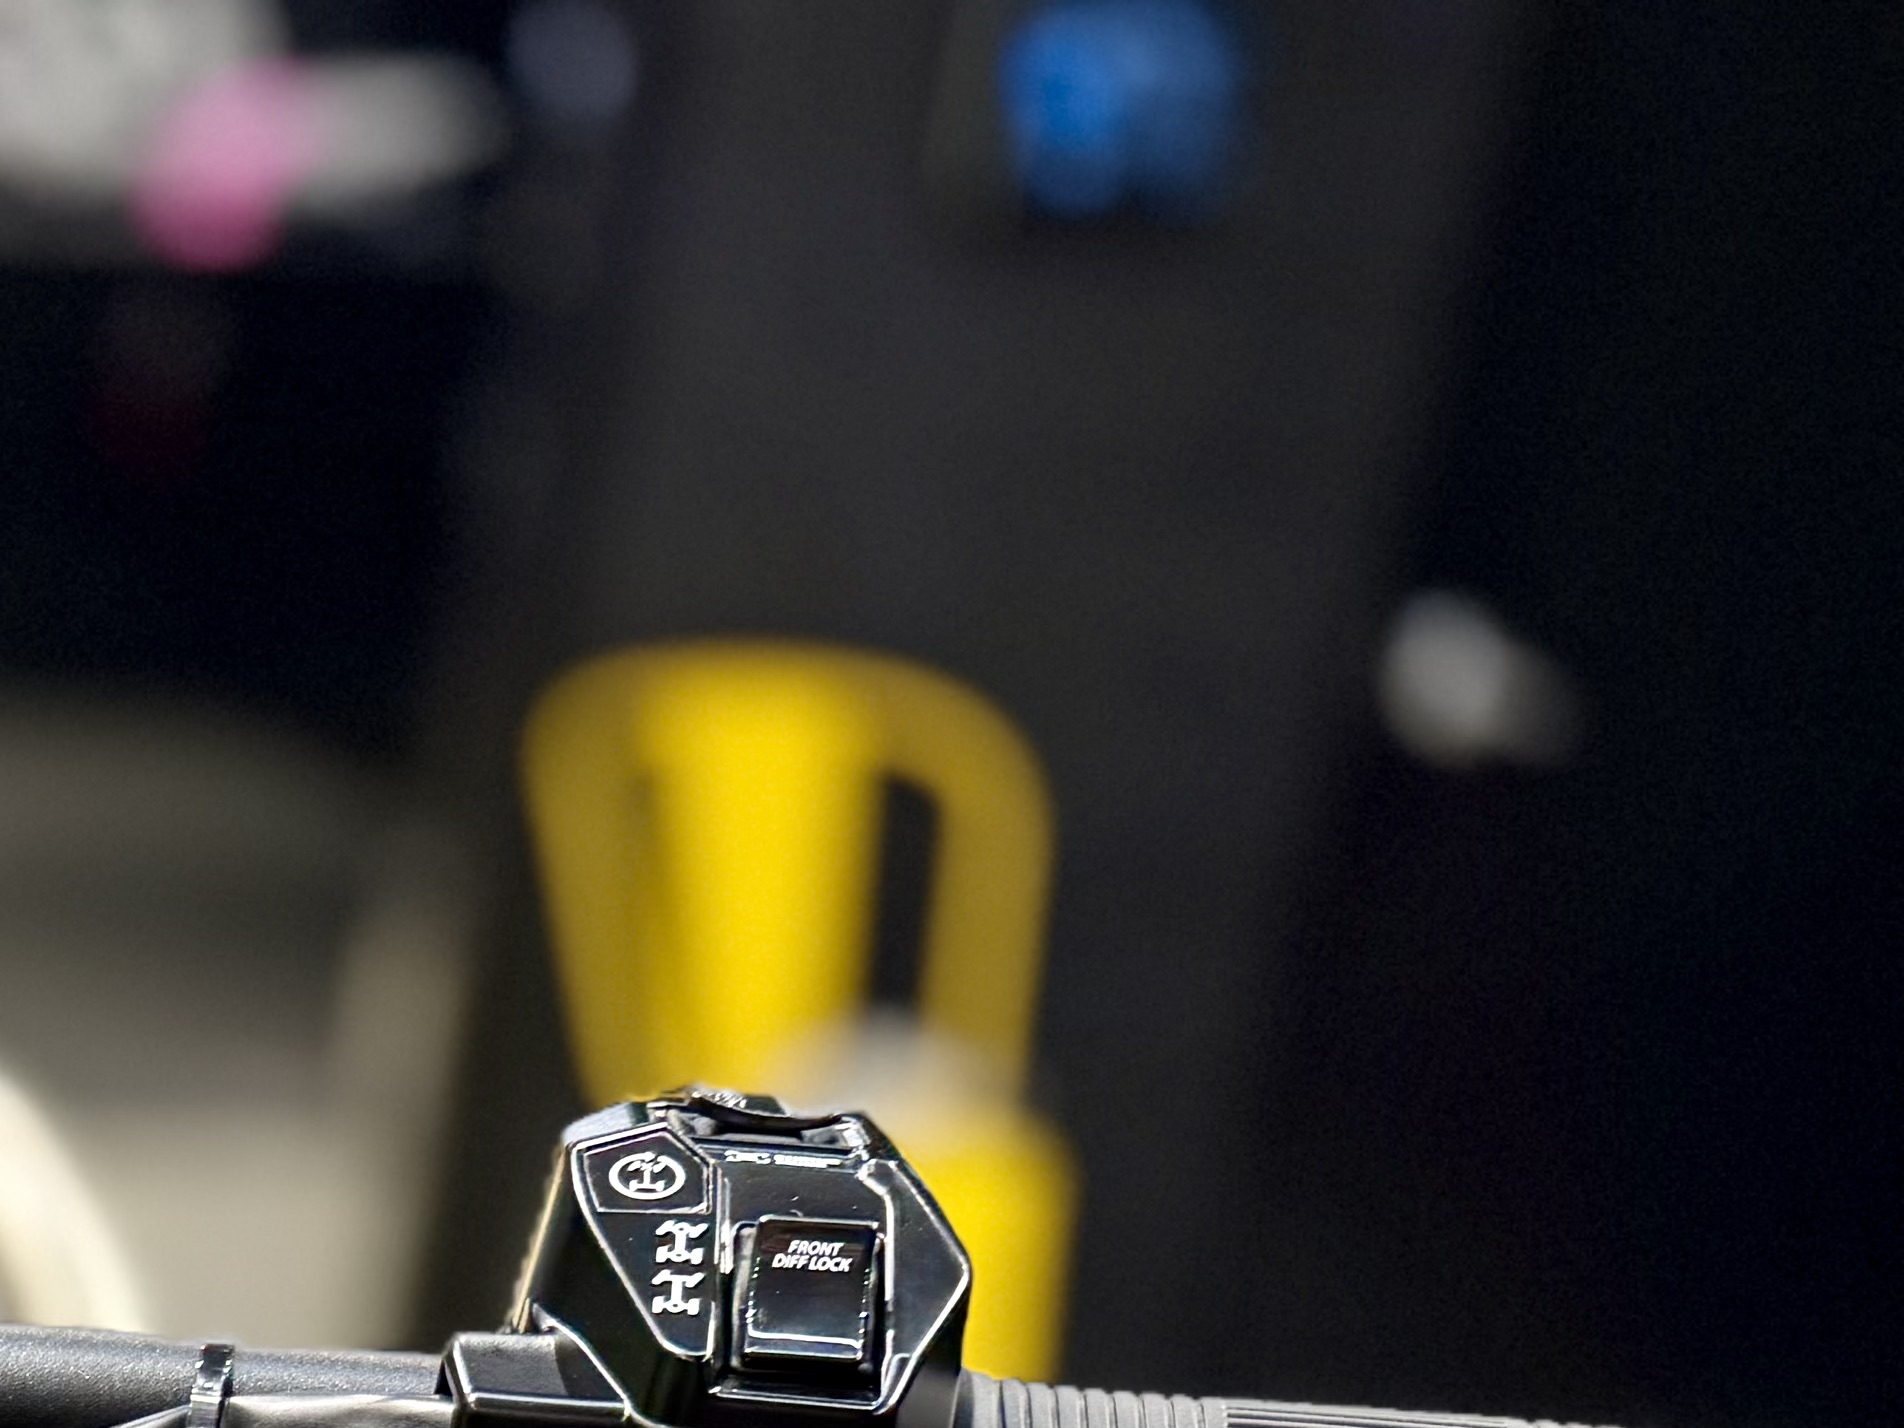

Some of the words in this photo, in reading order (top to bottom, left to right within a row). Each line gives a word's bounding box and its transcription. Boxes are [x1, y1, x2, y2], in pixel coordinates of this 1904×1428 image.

[787, 1239, 846, 1257] FRONT
[771, 1252, 812, 1270] DIFF
[808, 1255, 854, 1273] LOCK
